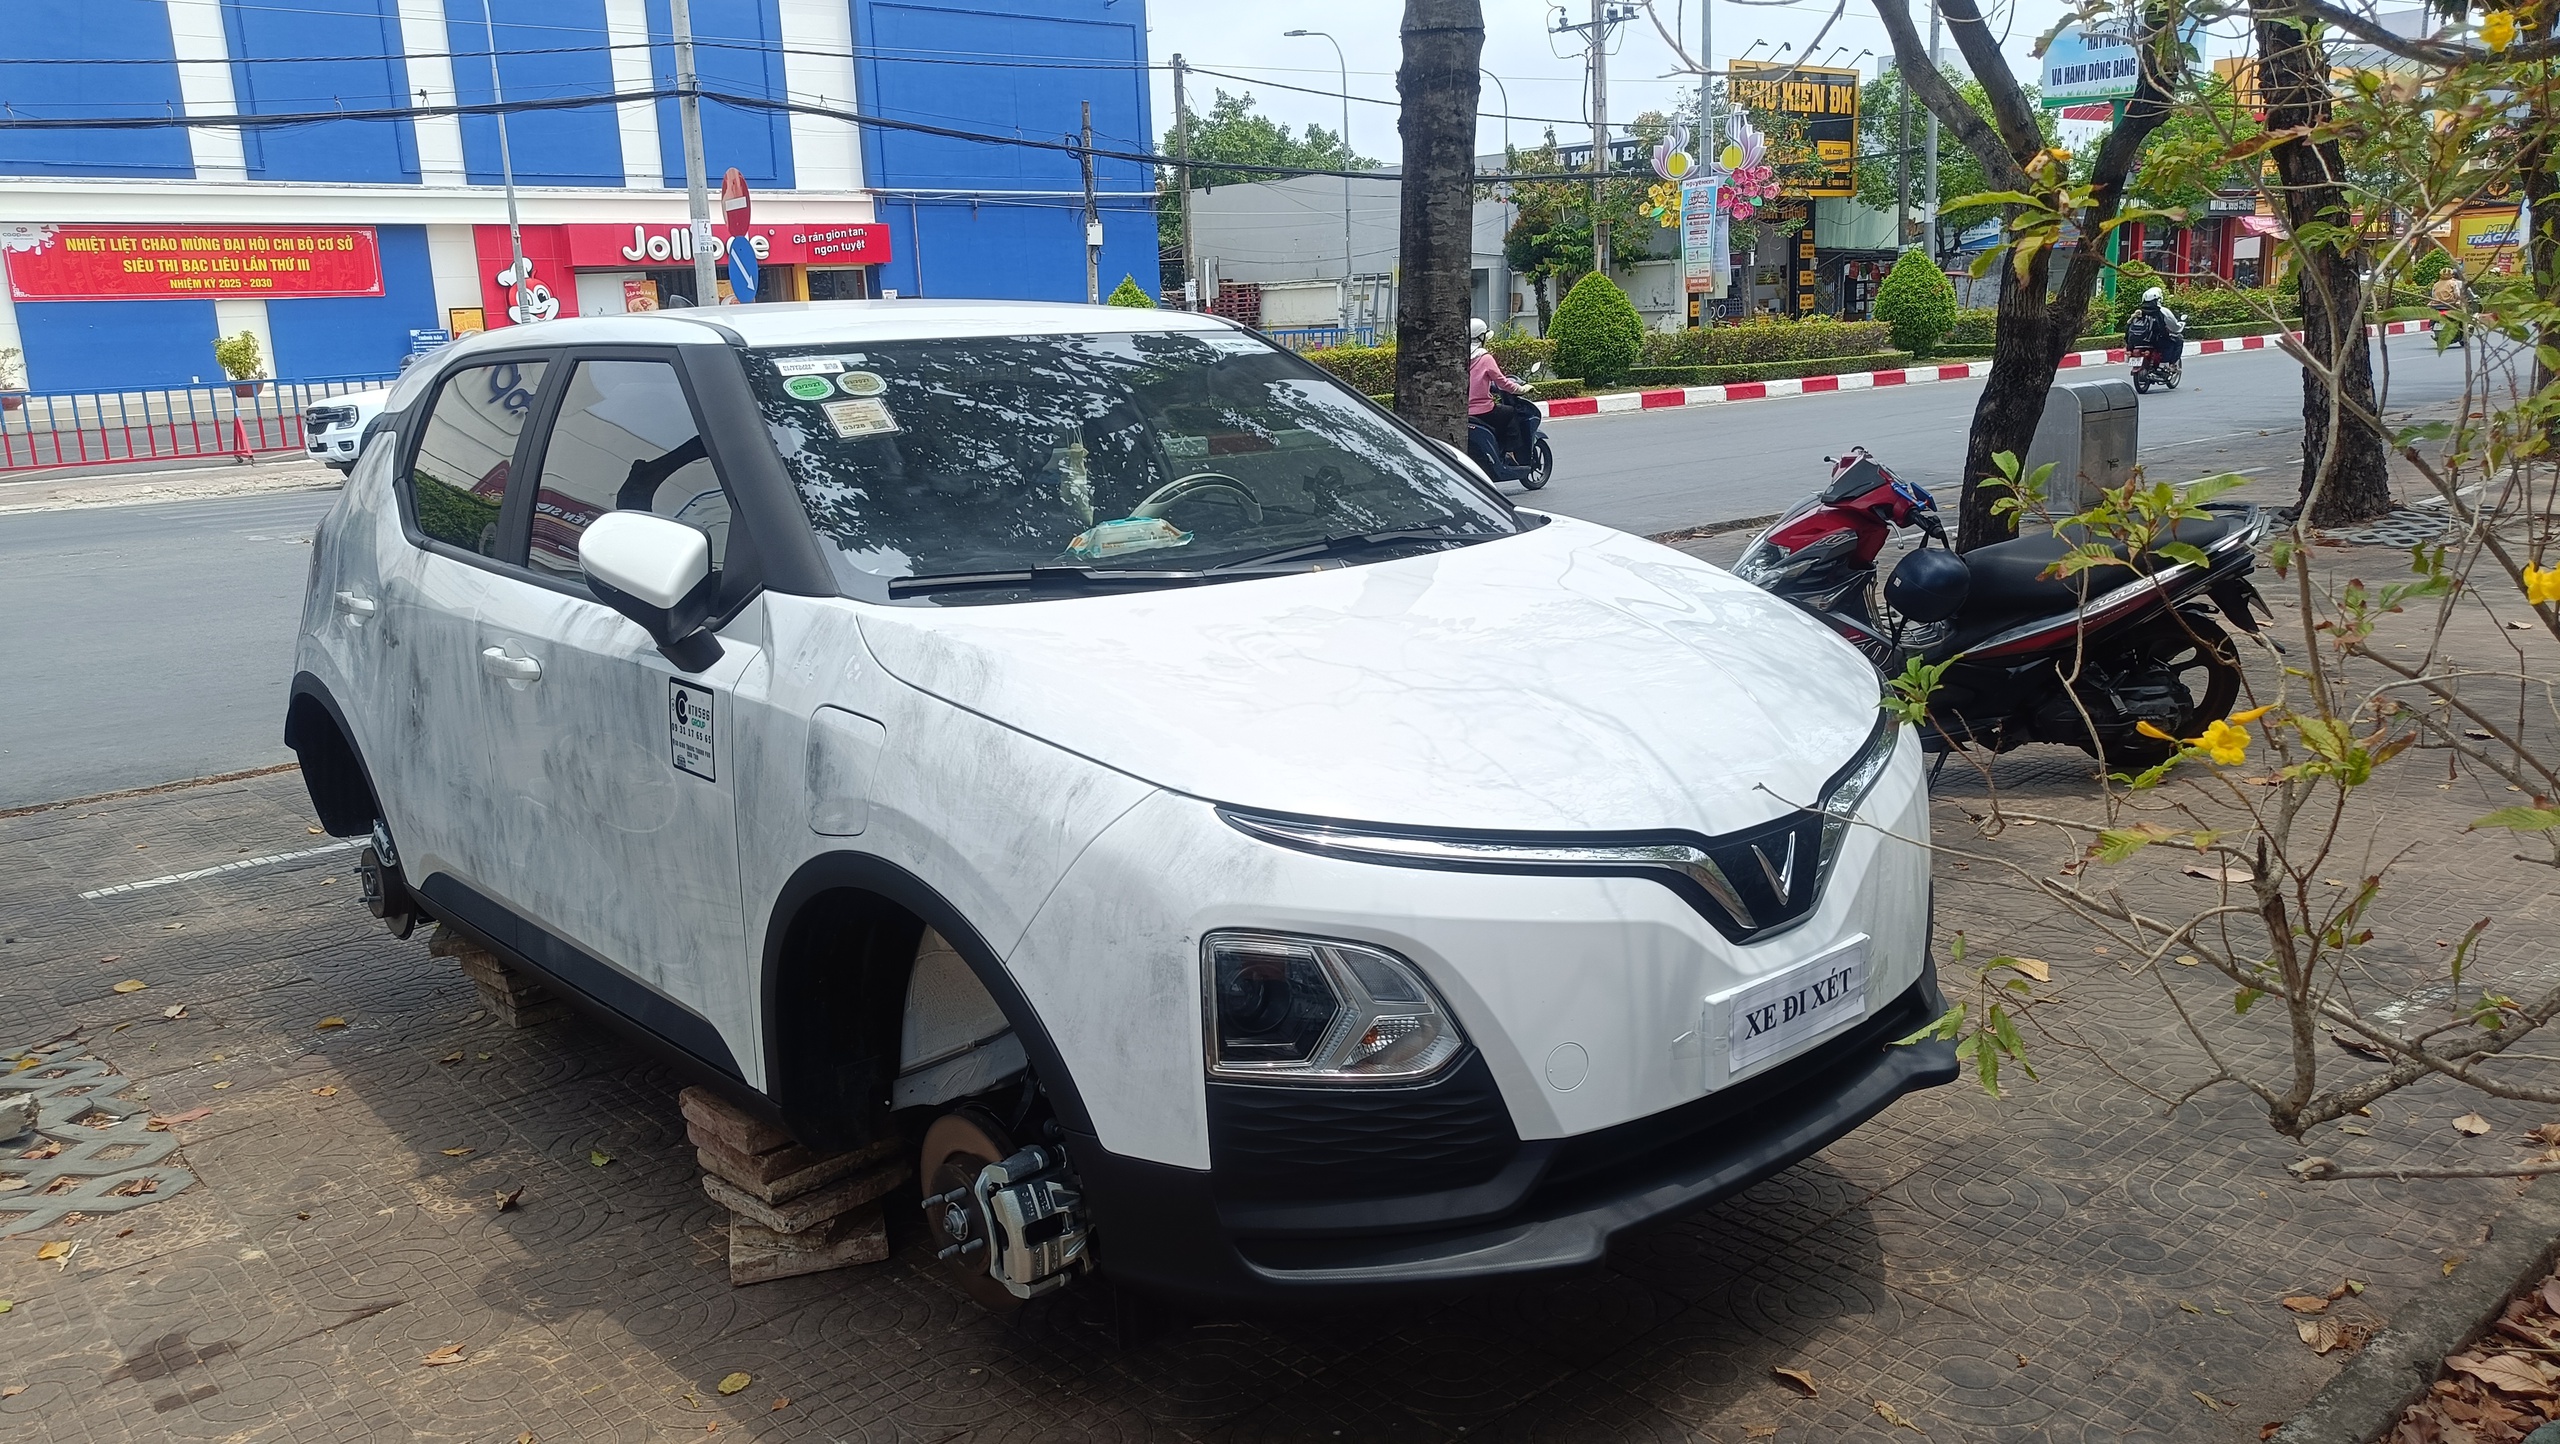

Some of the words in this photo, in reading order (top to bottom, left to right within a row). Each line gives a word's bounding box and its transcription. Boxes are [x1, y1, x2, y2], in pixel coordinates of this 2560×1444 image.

[2052, 65, 2062, 86] VÀ
[2064, 62, 2086, 84] HÀNH
[2088, 59, 2111, 84] ĐỘNG
[2113, 54, 2136, 77] BẰNG
[1782, 77, 1825, 117] KIỆN
[1829, 85, 1853, 114] ĐK
[65, 236, 106, 254] NHIỆT
[110, 236, 138, 254] LIỆT
[141, 236, 178, 251] CHÀO
[181, 236, 221, 251] MỪNG
[223, 237, 245, 253] ĐẠI
[248, 236, 271, 253] HỘI
[273, 238, 295, 251] CHI
[297, 236, 315, 253] BỘ
[317, 238, 335, 251] CƠ
[337, 235, 354, 251] SỞ
[793, 234, 806, 244] Gà
[808, 231, 824, 242] rán
[848, 228, 867, 237] tan,
[814, 244, 838, 256] ngon
[841, 239, 865, 251] tuyệt
[123, 257, 154, 273] SIÊU
[156, 259, 179, 275] THỊ
[182, 259, 209, 275] BẠC
[211, 256, 240, 272] LIÊU
[242, 255, 268, 272] LẦN
[270, 256, 296, 272] THỨ
[297, 258, 310, 272] III
[170, 277, 202, 291] NHIỆM
[204, 277, 216, 289] KỲ
[219, 278, 242, 288] 2025
[250, 278, 273, 288] 2030
[679, 725, 686, 735] 31
[688, 728, 694, 738] 17
[1745, 1003, 1777, 1040] XE
[1782, 989, 1807, 1023] ĐI
[1811, 967, 1852, 1010] XÉT
